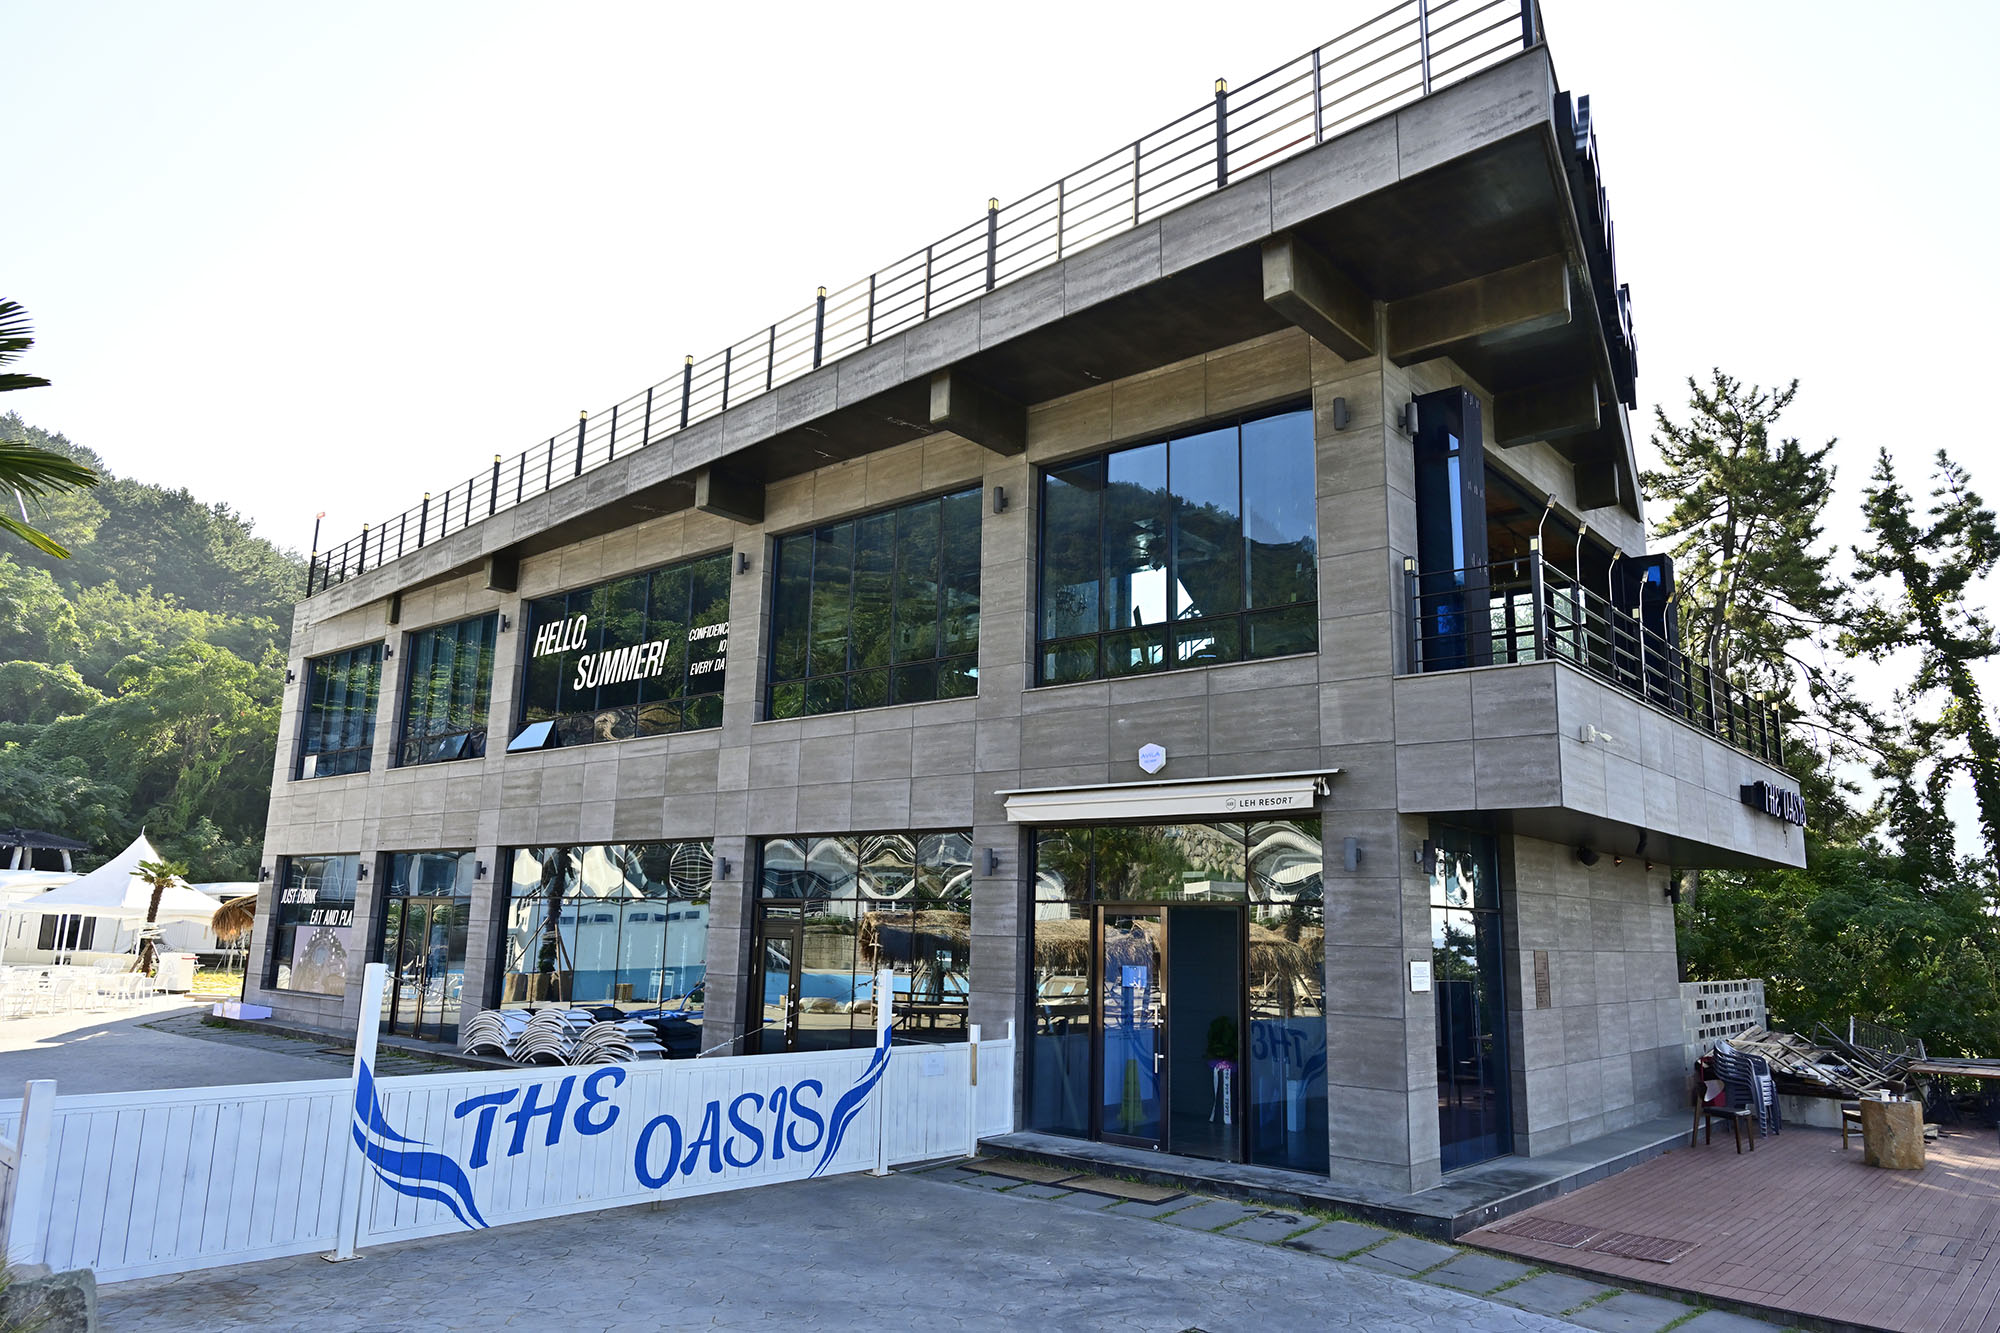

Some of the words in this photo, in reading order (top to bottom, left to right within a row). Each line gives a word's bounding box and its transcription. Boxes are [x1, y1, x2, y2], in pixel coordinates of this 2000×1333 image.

[533, 615, 588, 658] HELLO,
[689, 622, 729, 642] CONFIDENC
[716, 638, 728, 653] JO
[573, 639, 670, 691] SUMMER!
[690, 660, 714, 676] EVERY
[714, 657, 726, 671] DA
[1239, 799, 1256, 808] LEH
[1258, 796, 1294, 806] RESORT
[1763, 780, 1781, 817] THE
[280, 888, 299, 904] JUST
[297, 888, 318, 905] DRINK
[309, 909, 324, 926] EAT
[322, 909, 340, 926] AND
[338, 910, 353, 926] PLA
[454, 1066, 627, 1170] THE
[633, 1079, 825, 1189] OASIS
